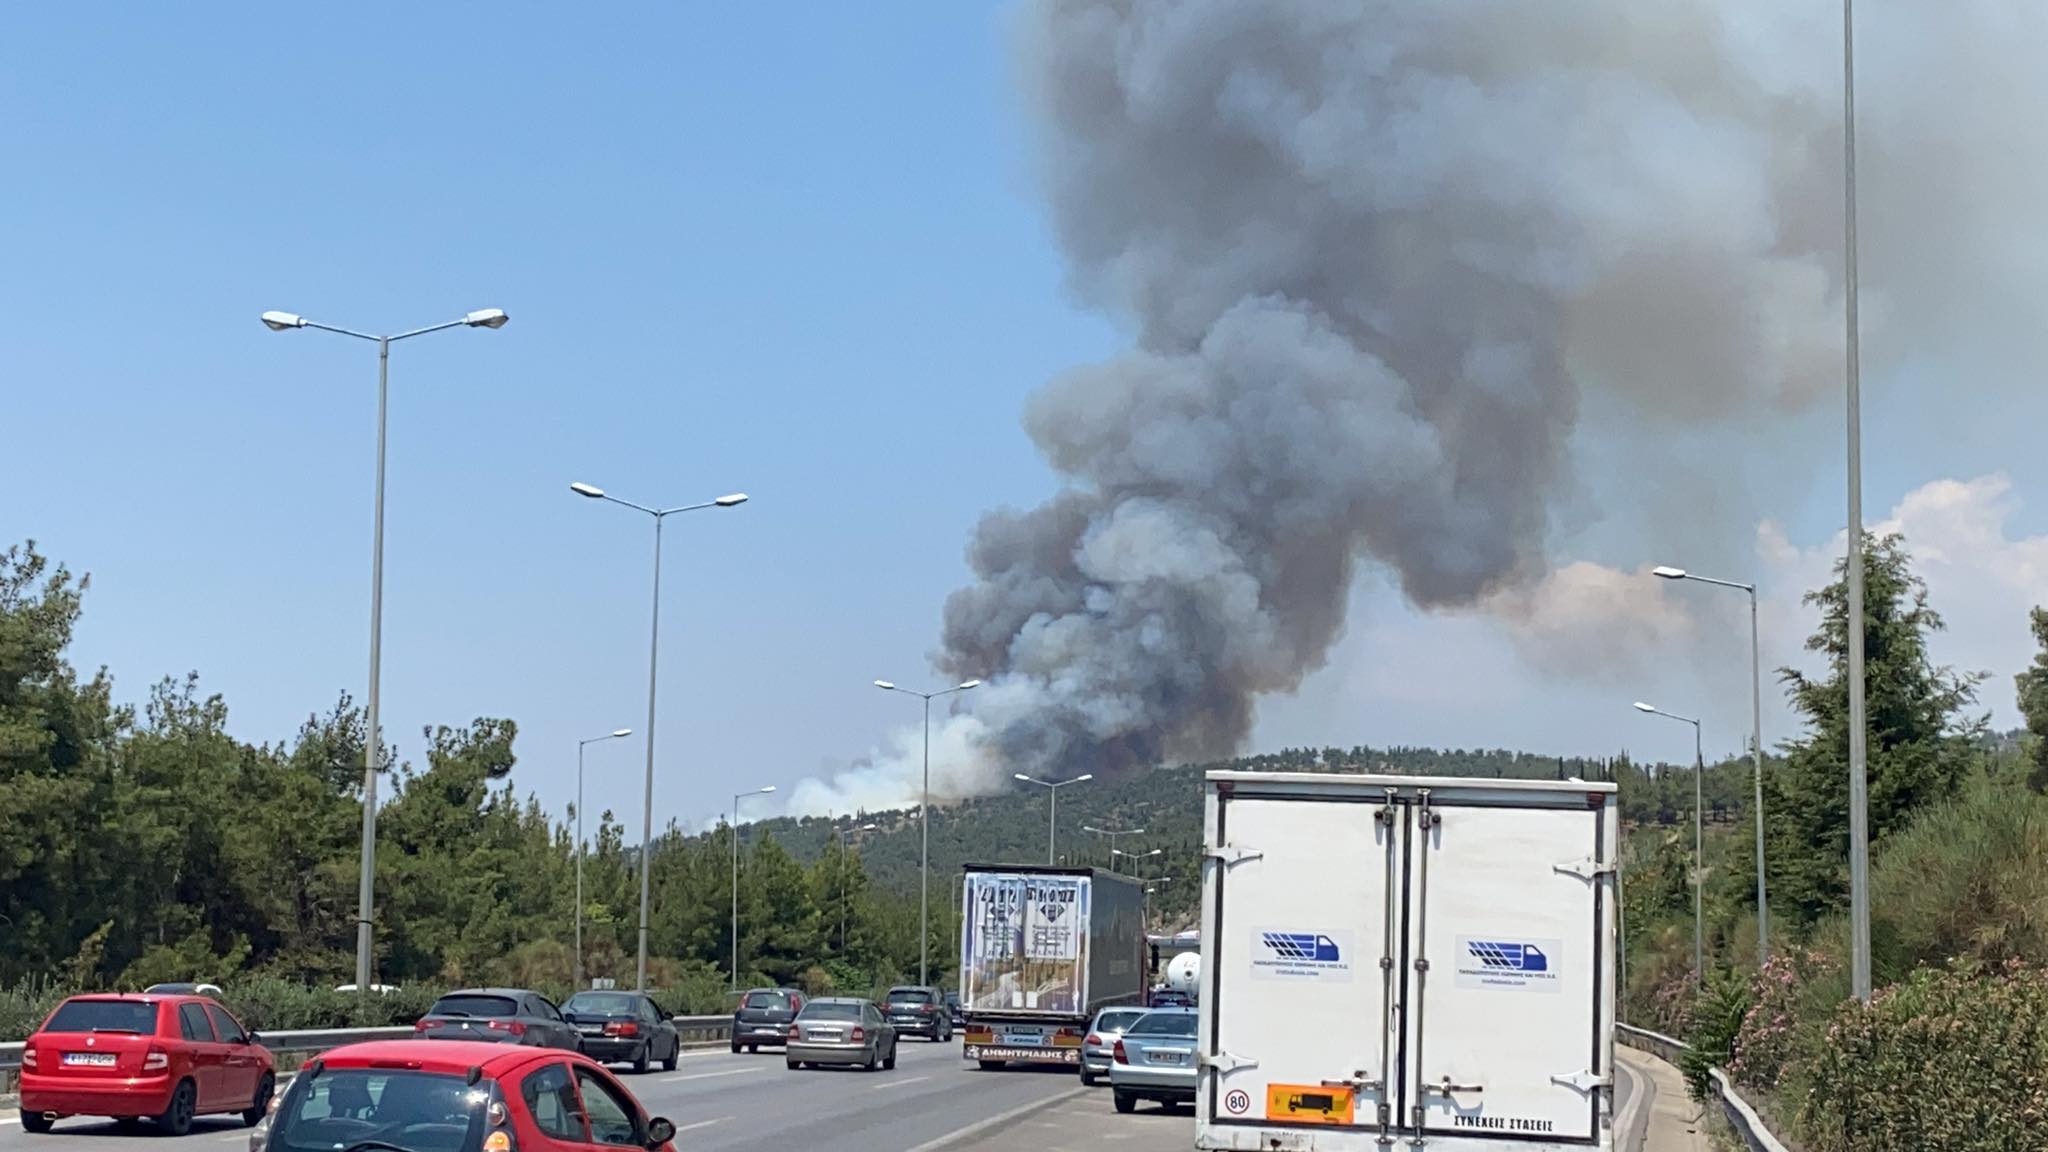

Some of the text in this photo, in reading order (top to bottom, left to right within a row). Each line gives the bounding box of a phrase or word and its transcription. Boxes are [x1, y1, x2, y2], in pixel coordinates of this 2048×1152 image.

[1230, 1096, 1245, 1109] 80
[1454, 1115, 1553, 1132] ΣΥΝΕΧΕΙΣ ΣΤΑΣΕΙΣ
